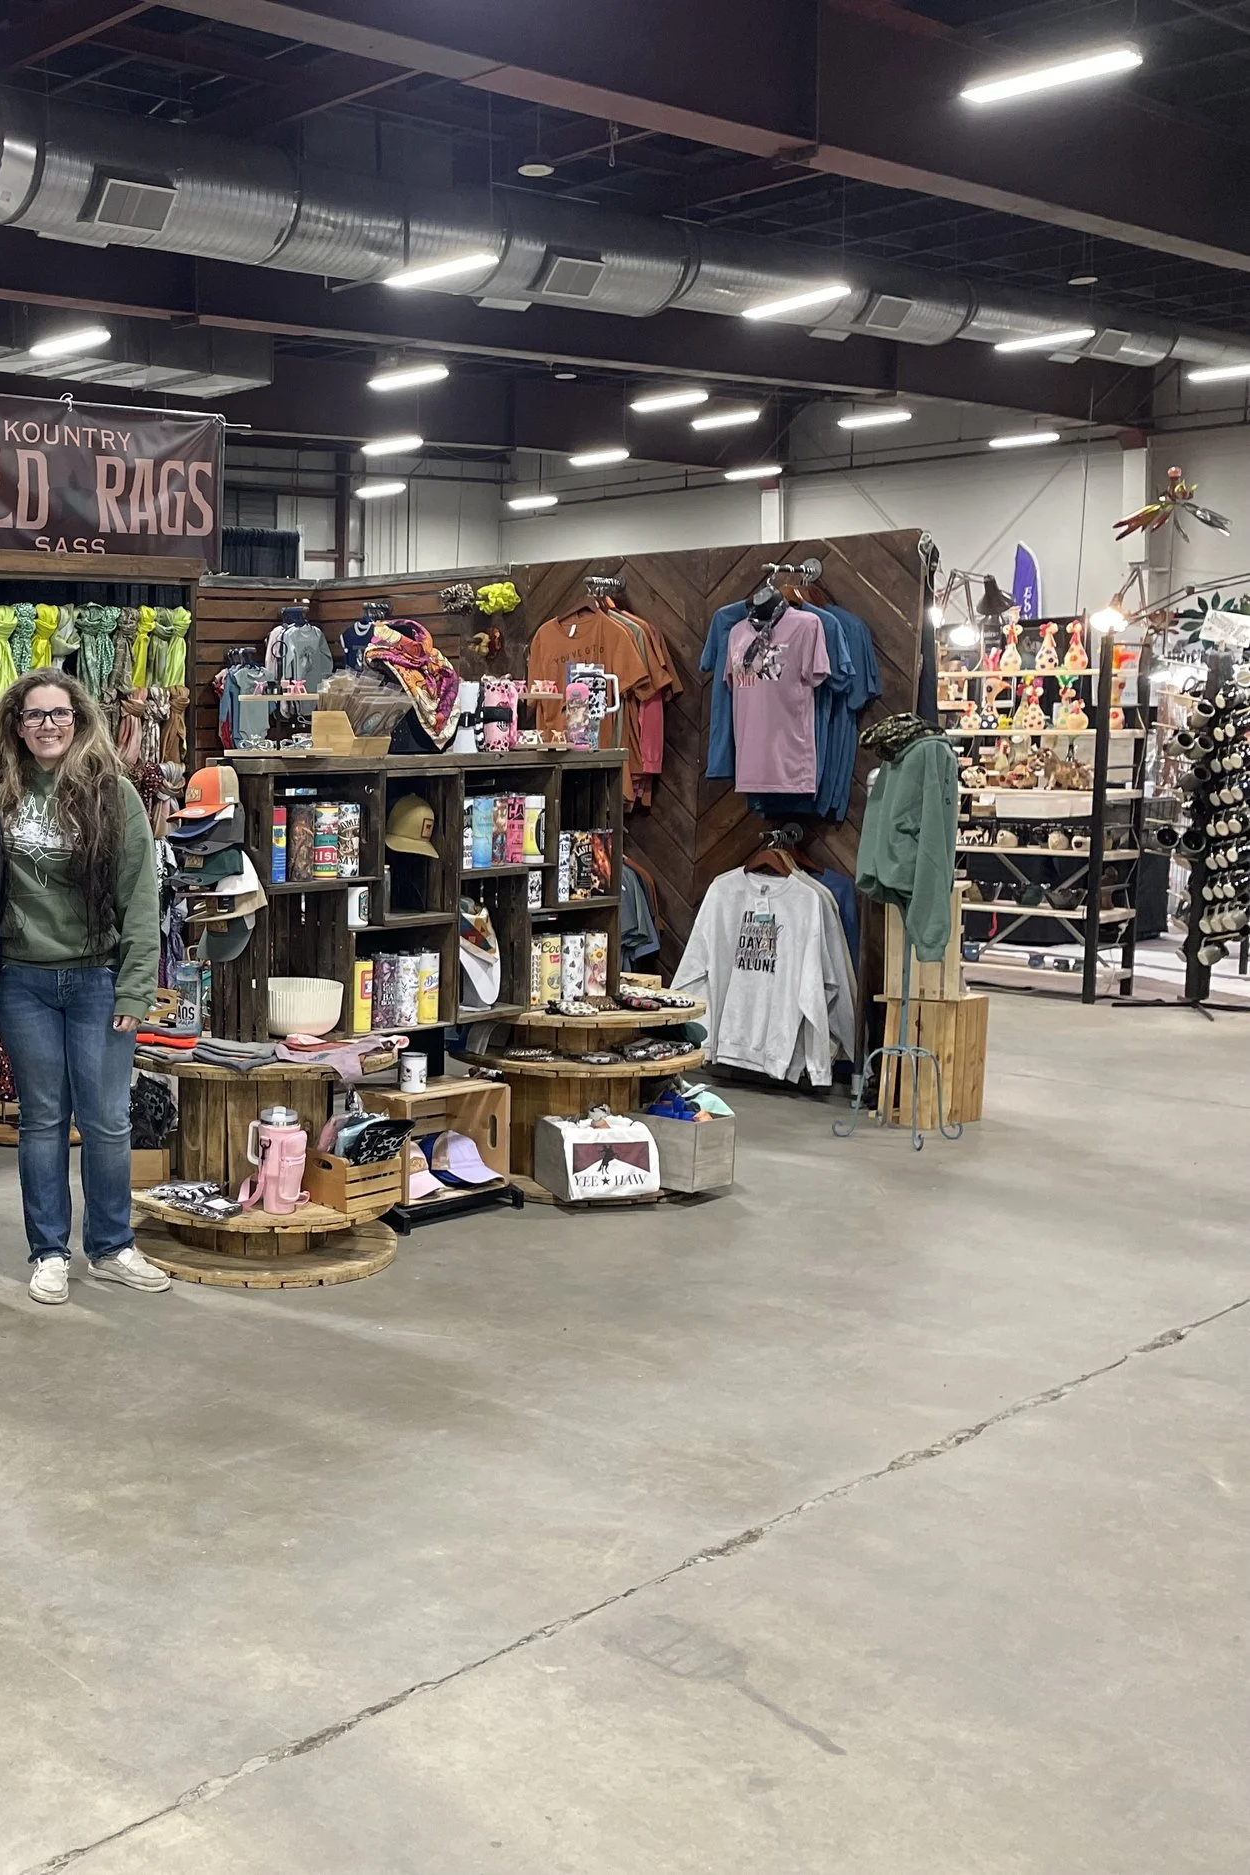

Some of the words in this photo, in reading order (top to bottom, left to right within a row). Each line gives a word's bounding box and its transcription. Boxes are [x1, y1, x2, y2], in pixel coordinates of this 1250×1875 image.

[4, 419, 131, 451] KOUNTRY
[95, 455, 214, 536] RAGS
[35, 536, 106, 554] SASS
[574, 1175, 599, 1187] YEE
[615, 1174, 647, 1186] HAW
